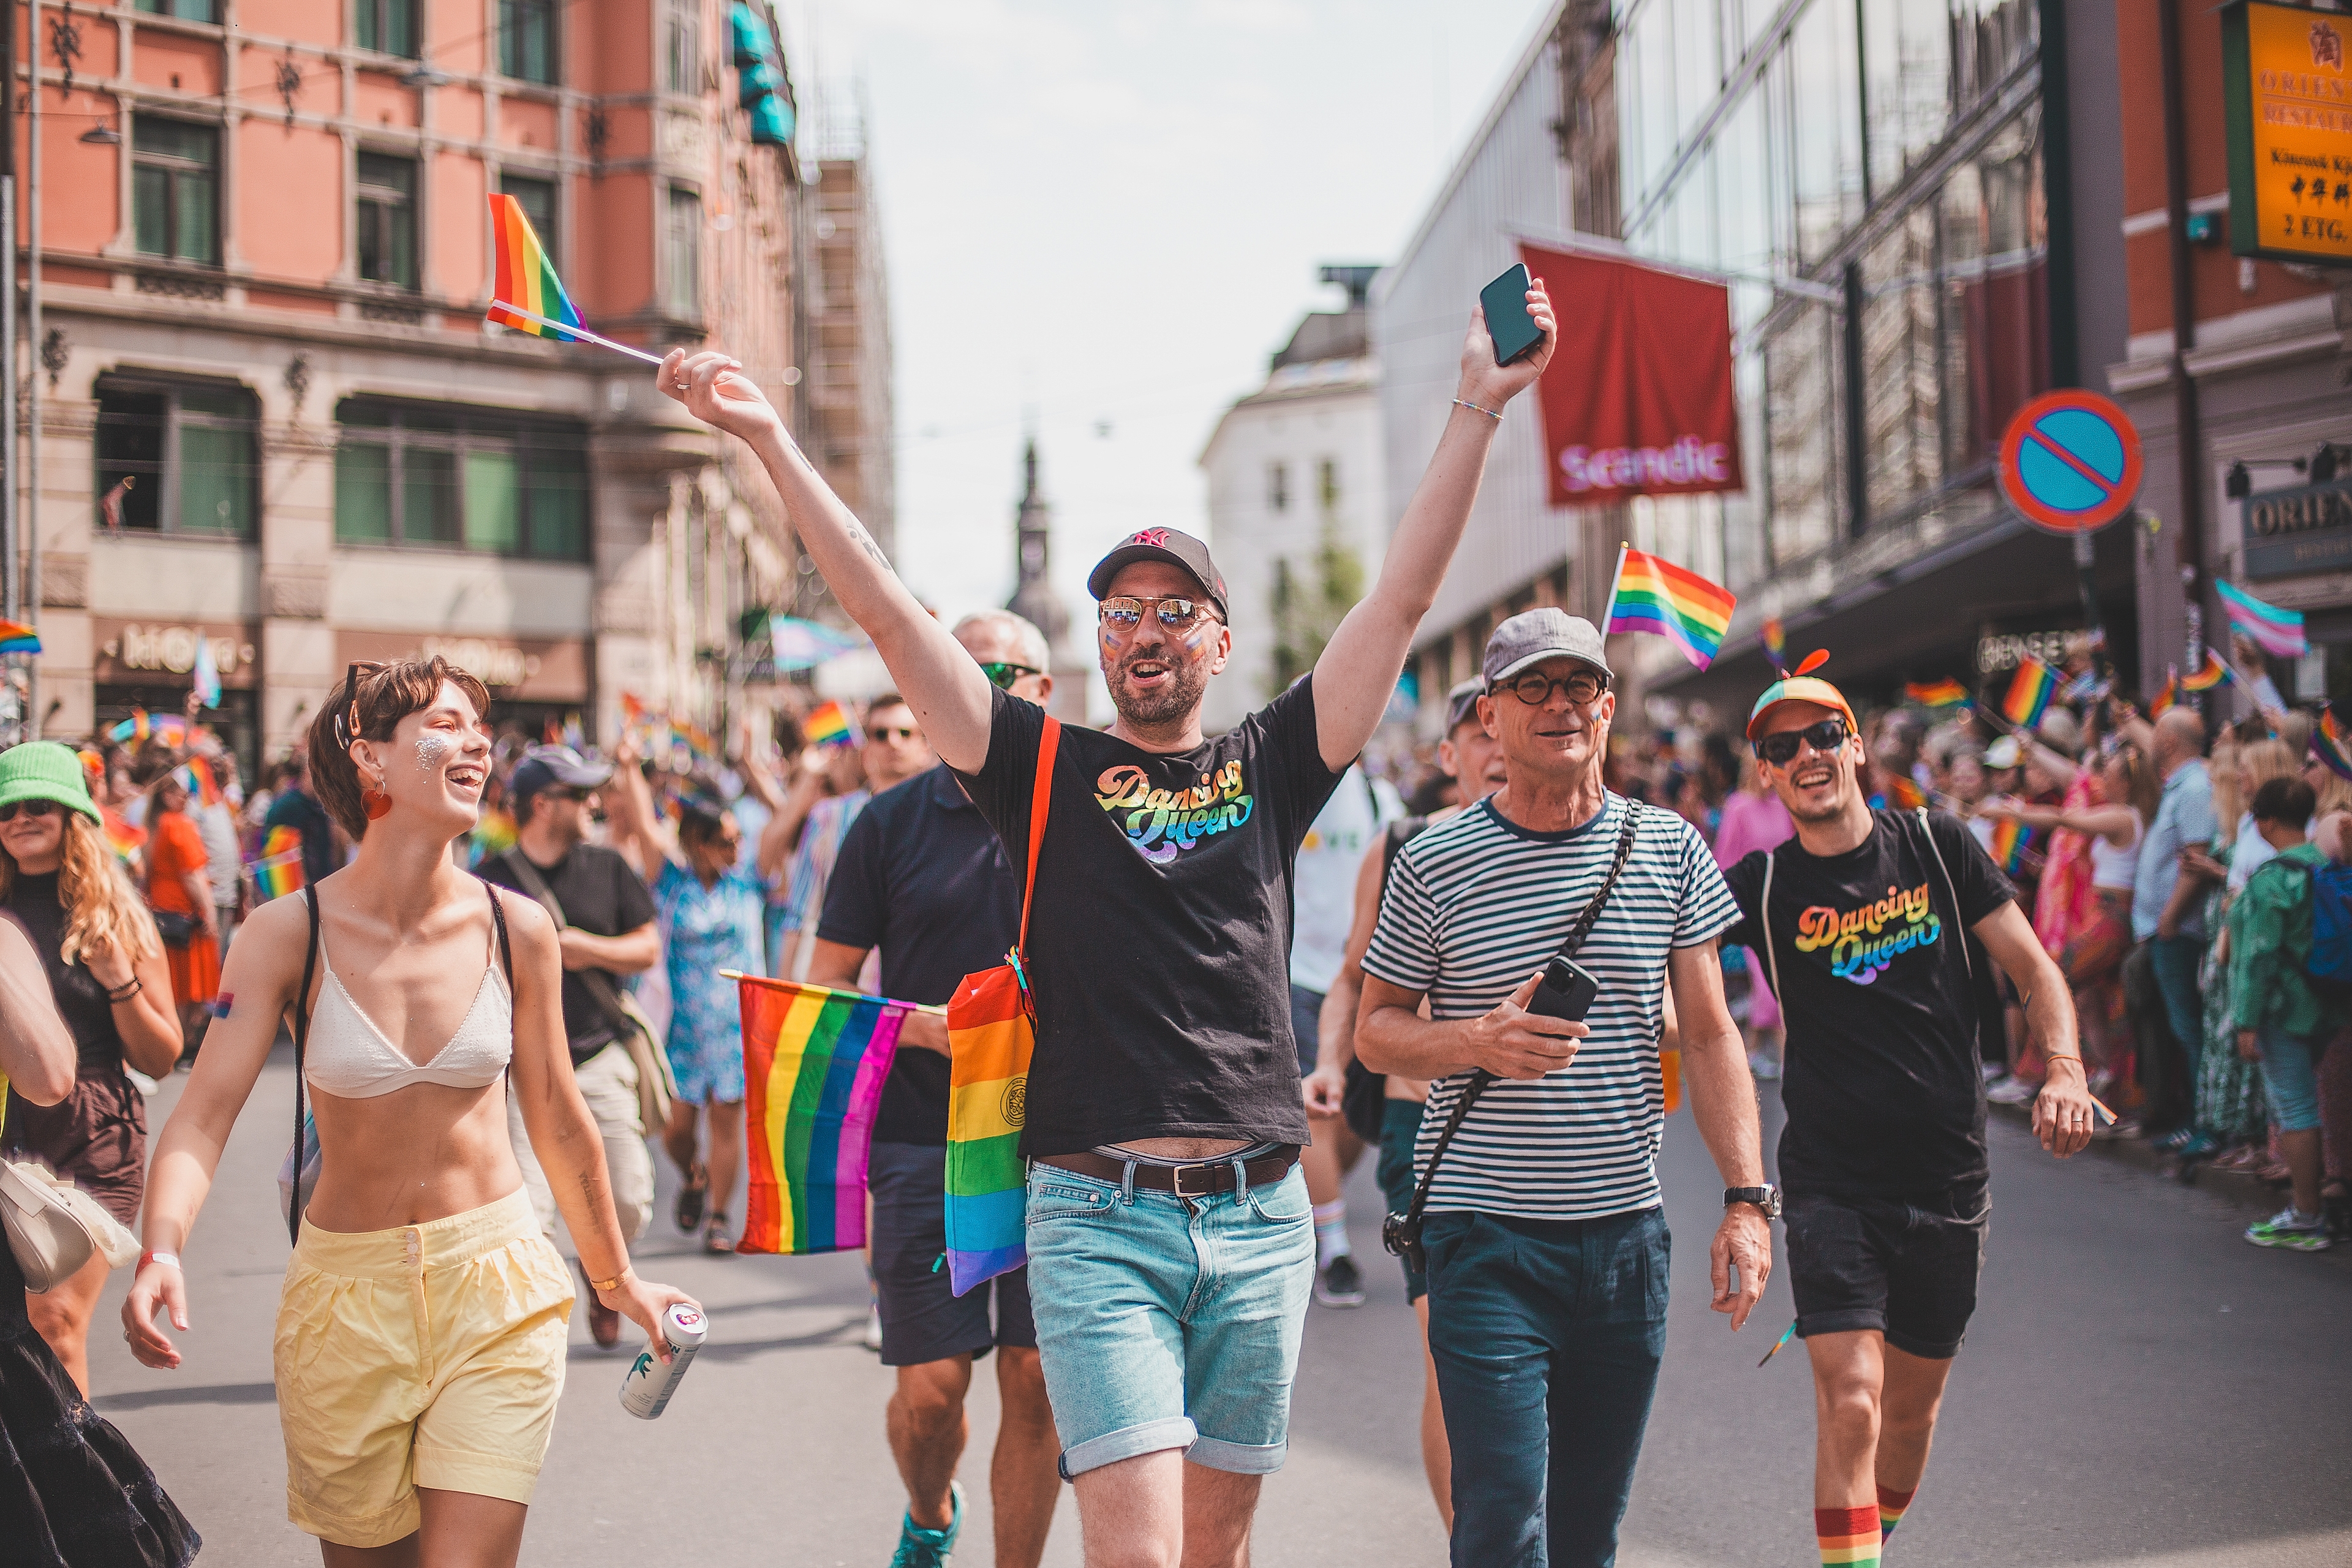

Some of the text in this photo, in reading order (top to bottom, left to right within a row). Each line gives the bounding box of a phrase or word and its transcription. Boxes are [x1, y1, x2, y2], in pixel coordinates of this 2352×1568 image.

[1559, 433, 1729, 492] Scandic
[1093, 759, 1243, 812] Dancing
[1126, 794, 1253, 864] Queen
[1795, 882, 1929, 952] Dancing
[1831, 912, 1941, 986] Queen
